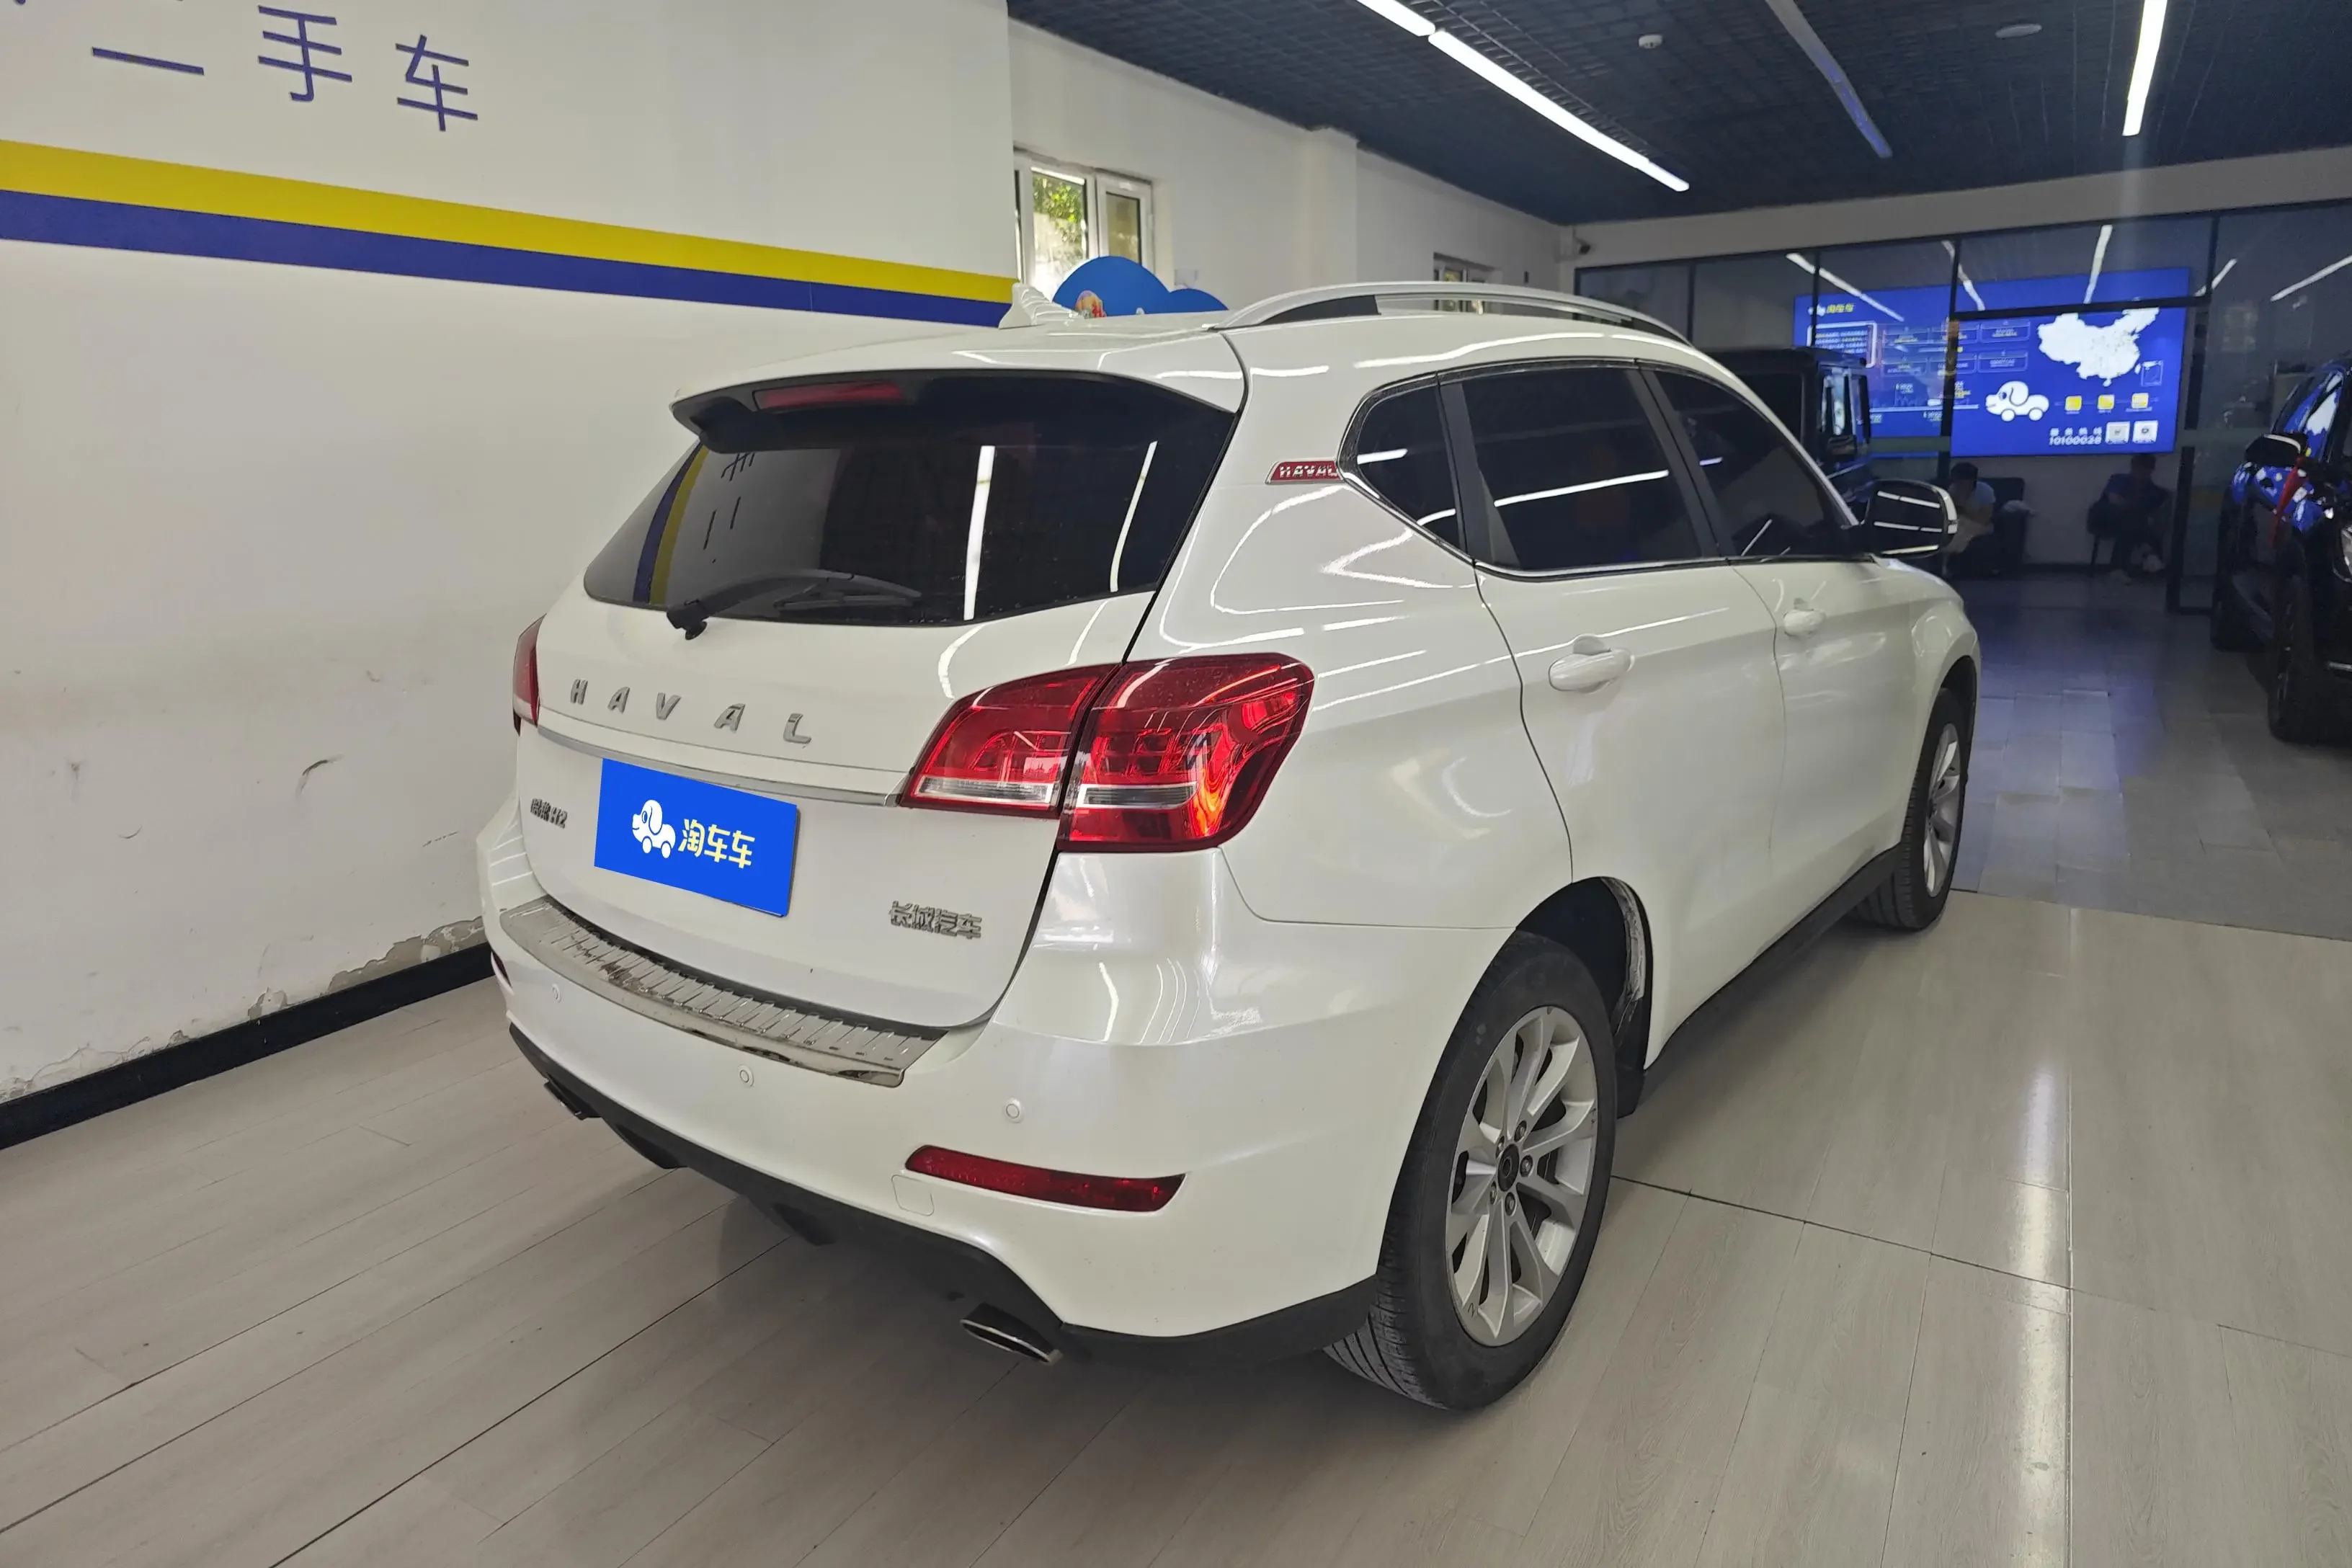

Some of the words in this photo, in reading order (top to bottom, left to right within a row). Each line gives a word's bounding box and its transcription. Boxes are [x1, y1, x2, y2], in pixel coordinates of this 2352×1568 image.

[1279, 465, 1338, 478] HAVAL
[570, 679, 812, 745] HAVAL
[888, 900, 982, 940] 长城汽车
